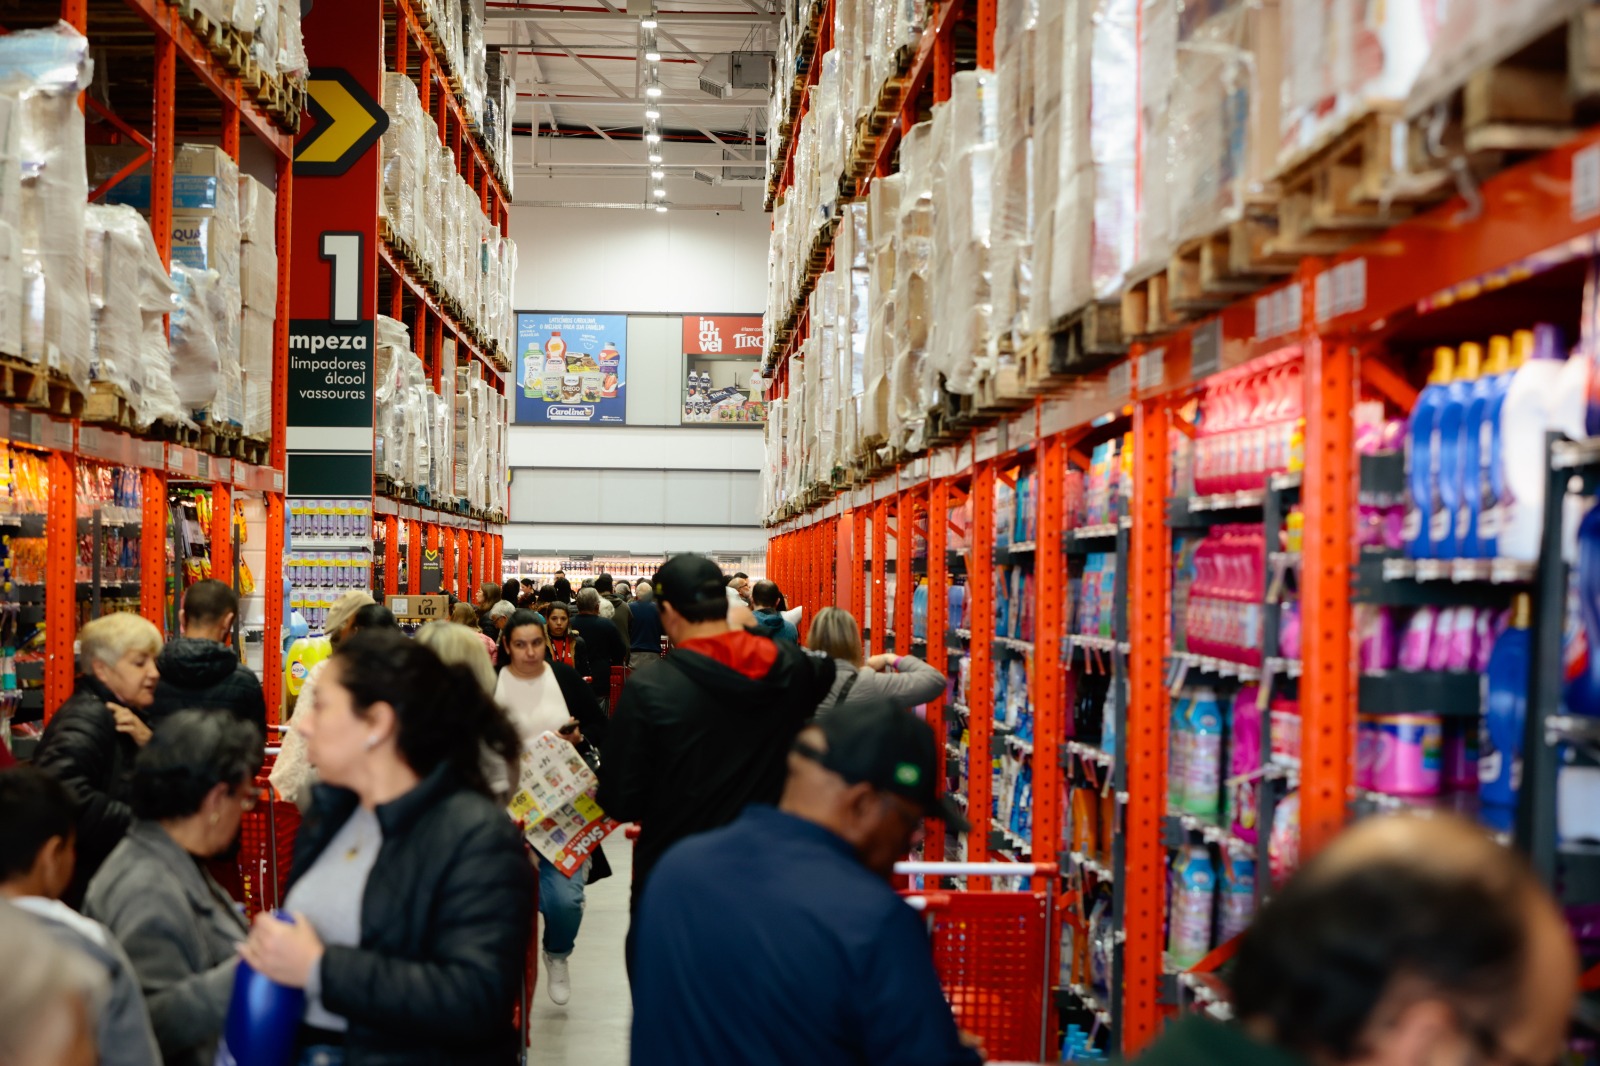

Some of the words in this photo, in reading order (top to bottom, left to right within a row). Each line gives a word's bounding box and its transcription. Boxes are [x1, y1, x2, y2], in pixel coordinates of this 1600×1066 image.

[172, 229, 200, 242] QUA
[324, 236, 358, 320] 1
[289, 335, 366, 354] mpeza
[291, 356, 366, 372] limpadores
[325, 371, 366, 384] álcool
[300, 390, 366, 400] vassouras
[550, 408, 584, 416] Carolina
[418, 605, 437, 615] Lar
[572, 826, 604, 856] Stok
